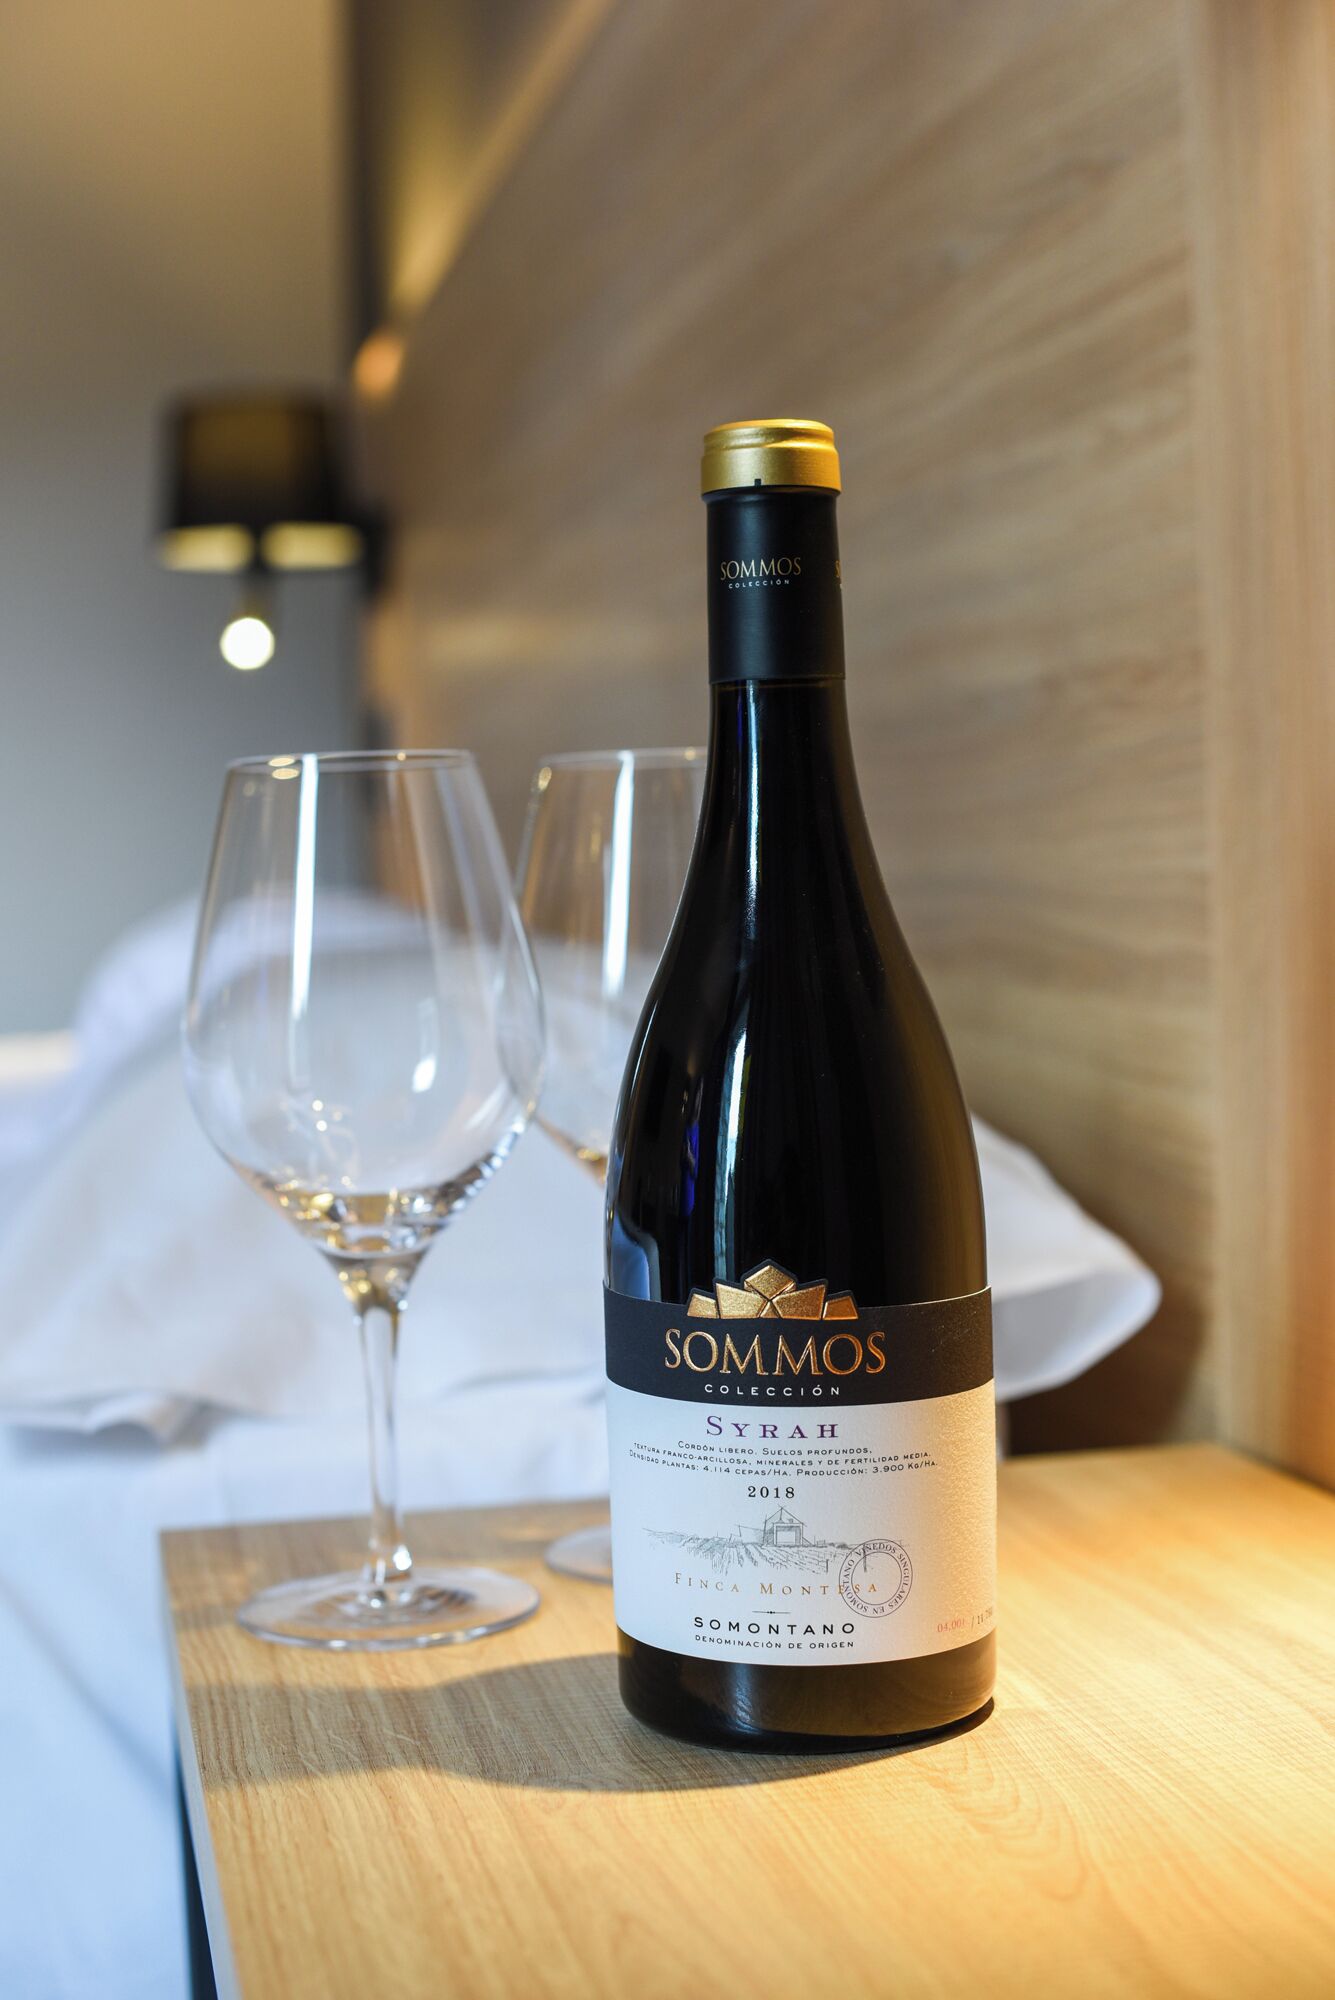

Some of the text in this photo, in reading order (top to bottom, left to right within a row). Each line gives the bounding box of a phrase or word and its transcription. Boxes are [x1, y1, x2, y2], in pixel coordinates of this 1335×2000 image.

[720, 557, 801, 580] SOMMOS
[728, 578, 790, 589] COLECCIÓN
[664, 1328, 887, 1376] SOMMOS
[704, 1383, 841, 1397] COLECCIÓN
[706, 1415, 840, 1439] SYRAH
[633, 1442, 660, 1454] TEXTURA
[756, 1459, 814, 1467] MINERALES
[844, 1455, 899, 1465] FERTILIDAD
[703, 1465, 731, 1474] 4.114
[872, 1464, 904, 1474] 3.900
[747, 1485, 795, 1499] 2018
[674, 1572, 740, 1593] FINCA
[694, 1616, 855, 1635] SOMONTANO
[695, 1635, 782, 1649] DENOMINACIÓN
[809, 1641, 854, 1649] ORIGEN
